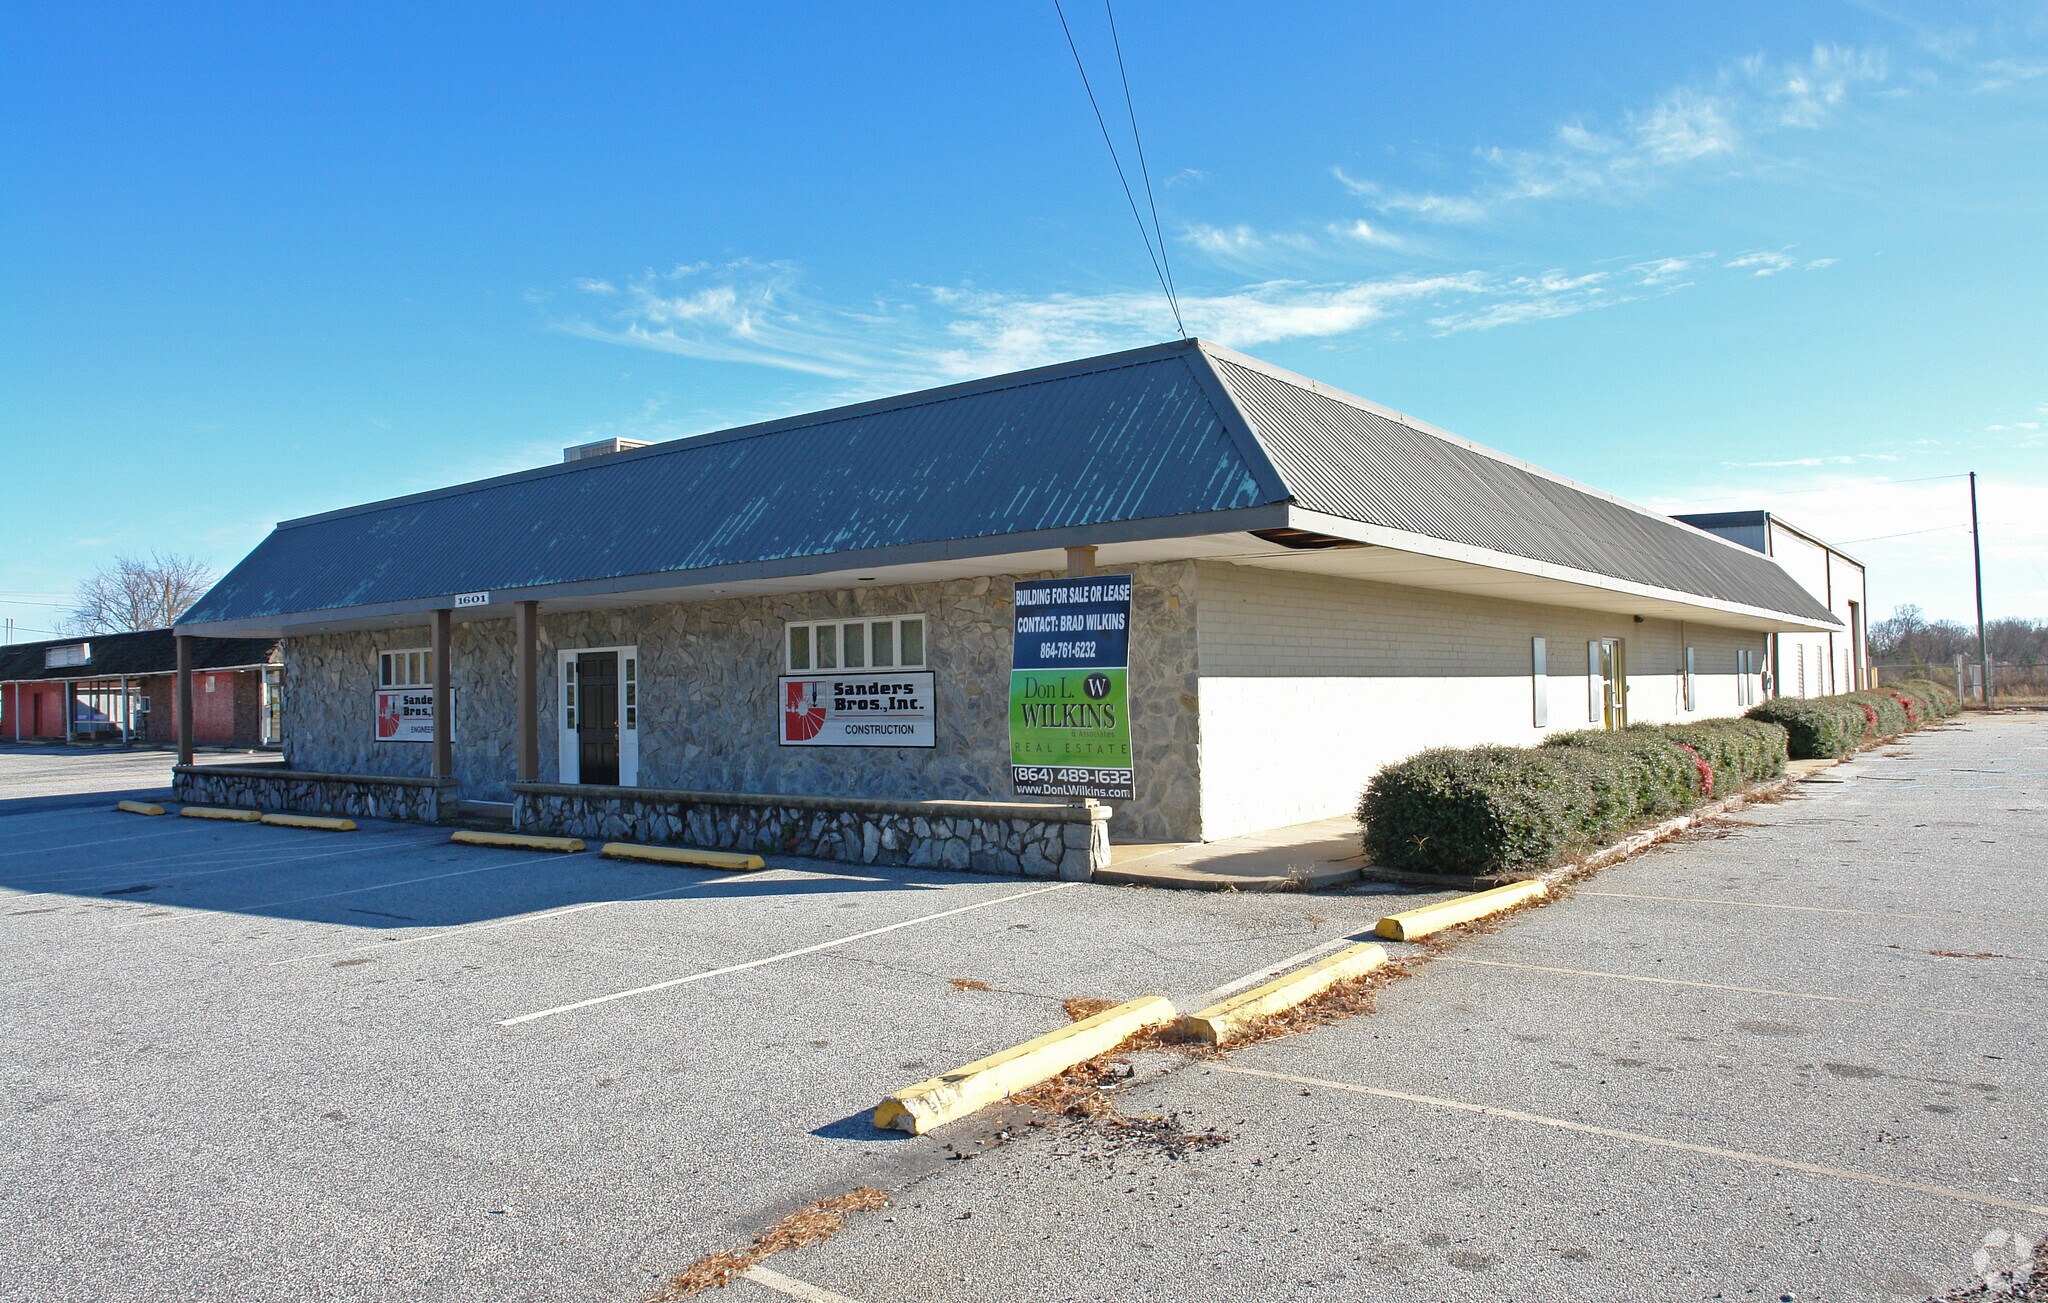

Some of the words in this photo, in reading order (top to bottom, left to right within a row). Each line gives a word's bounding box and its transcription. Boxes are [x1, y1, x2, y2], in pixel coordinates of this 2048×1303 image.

[458, 594, 486, 605] 1601
[1016, 589, 1050, 606] BUILDING
[1052, 587, 1068, 604] FOR
[1069, 586, 1089, 603] SALE
[1091, 585, 1101, 602] OR
[1103, 584, 1130, 602] LEASE
[1017, 615, 1058, 633] CONTACT:
[1060, 614, 1084, 632] BRAD
[1086, 613, 1125, 630] WILKINS
[1040, 641, 1096, 659] 864-761-6232
[834, 682, 914, 696] Sanders
[1024, 676, 1055, 699] Don
[1060, 676, 1075, 698] L.
[1088, 678, 1106, 697] W
[403, 695, 433, 705] Sande
[1021, 703, 1117, 730] WILKINS
[845, 724, 914, 735] CONSTRUCTION
[1078, 730, 1115, 738] Associates
[1015, 742, 1053, 752] REAL
[1065, 743, 1128, 755] ESTATE
[1014, 767, 1053, 782] (864)
[1057, 769, 1131, 784] 489-1632
[1016, 784, 1131, 798] www.DonLWilkins.com
